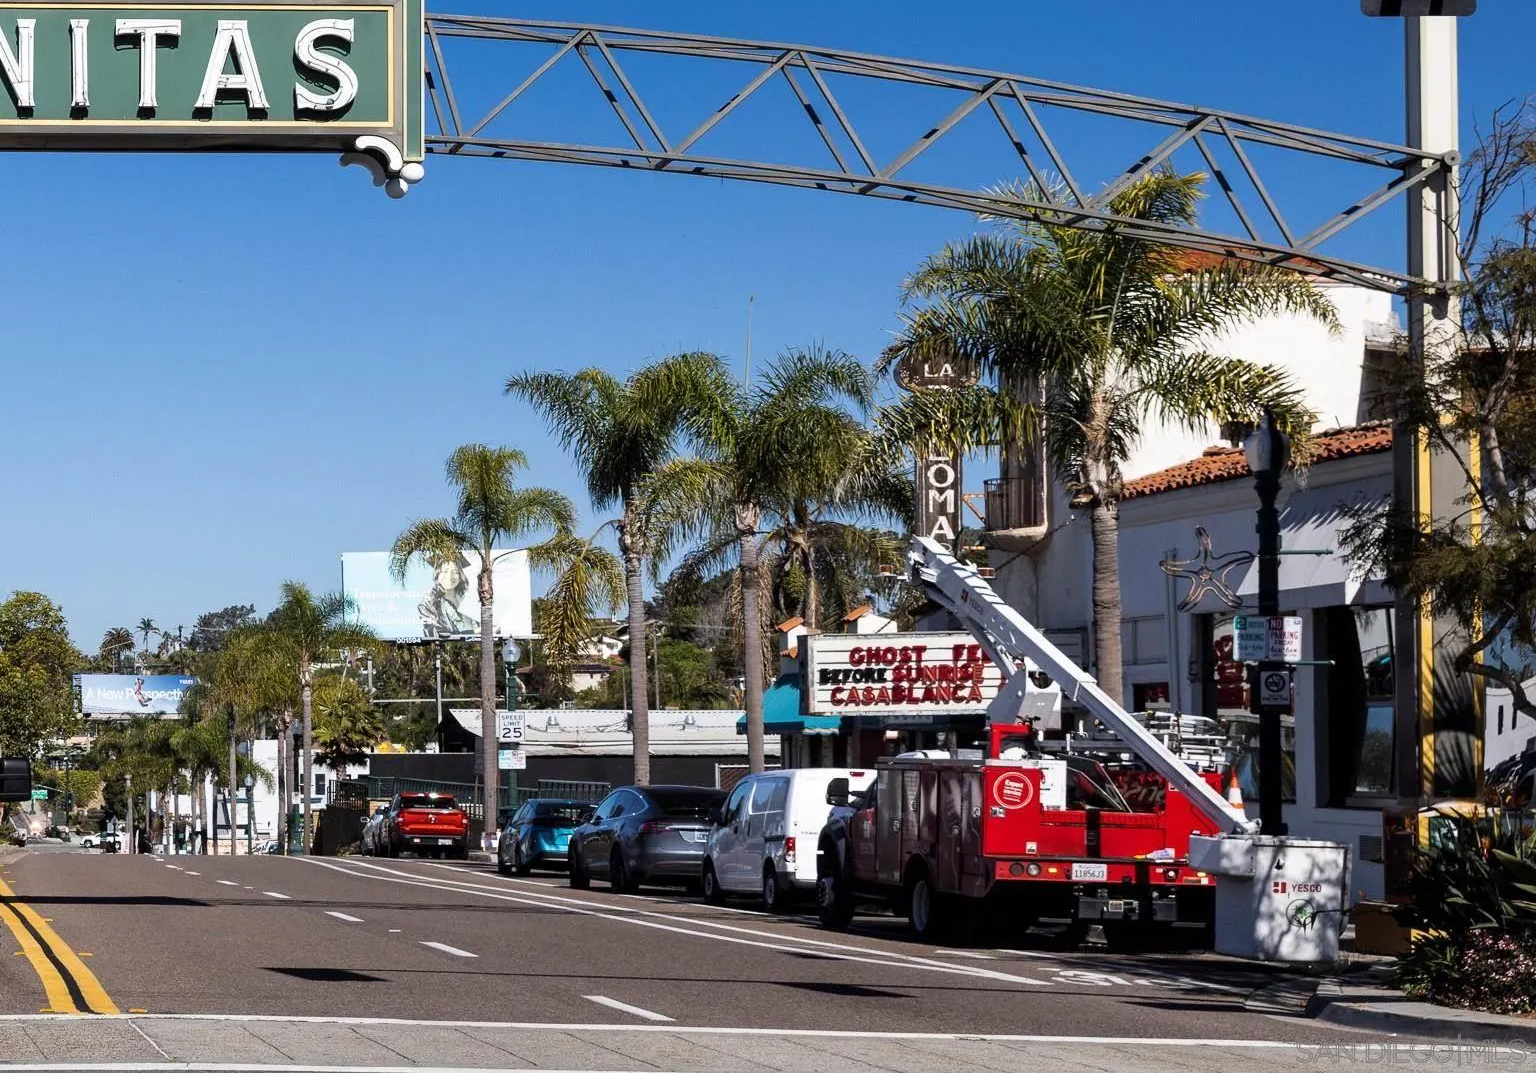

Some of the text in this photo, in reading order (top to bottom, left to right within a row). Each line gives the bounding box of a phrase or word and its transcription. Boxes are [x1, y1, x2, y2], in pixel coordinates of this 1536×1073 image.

[924, 363, 954, 377] LA
[1270, 619, 1283, 628] NO
[1270, 631, 1299, 640] PARKING
[848, 645, 928, 667] GHOST
[819, 667, 888, 686] BEFORE
[892, 663, 985, 686] SUNRISE
[86, 688, 97, 700] A
[97, 688, 125, 700] New
[830, 683, 983, 707] CASABLANCA
[502, 727, 523, 739] 25
[1291, 883, 1322, 893] YESCO
